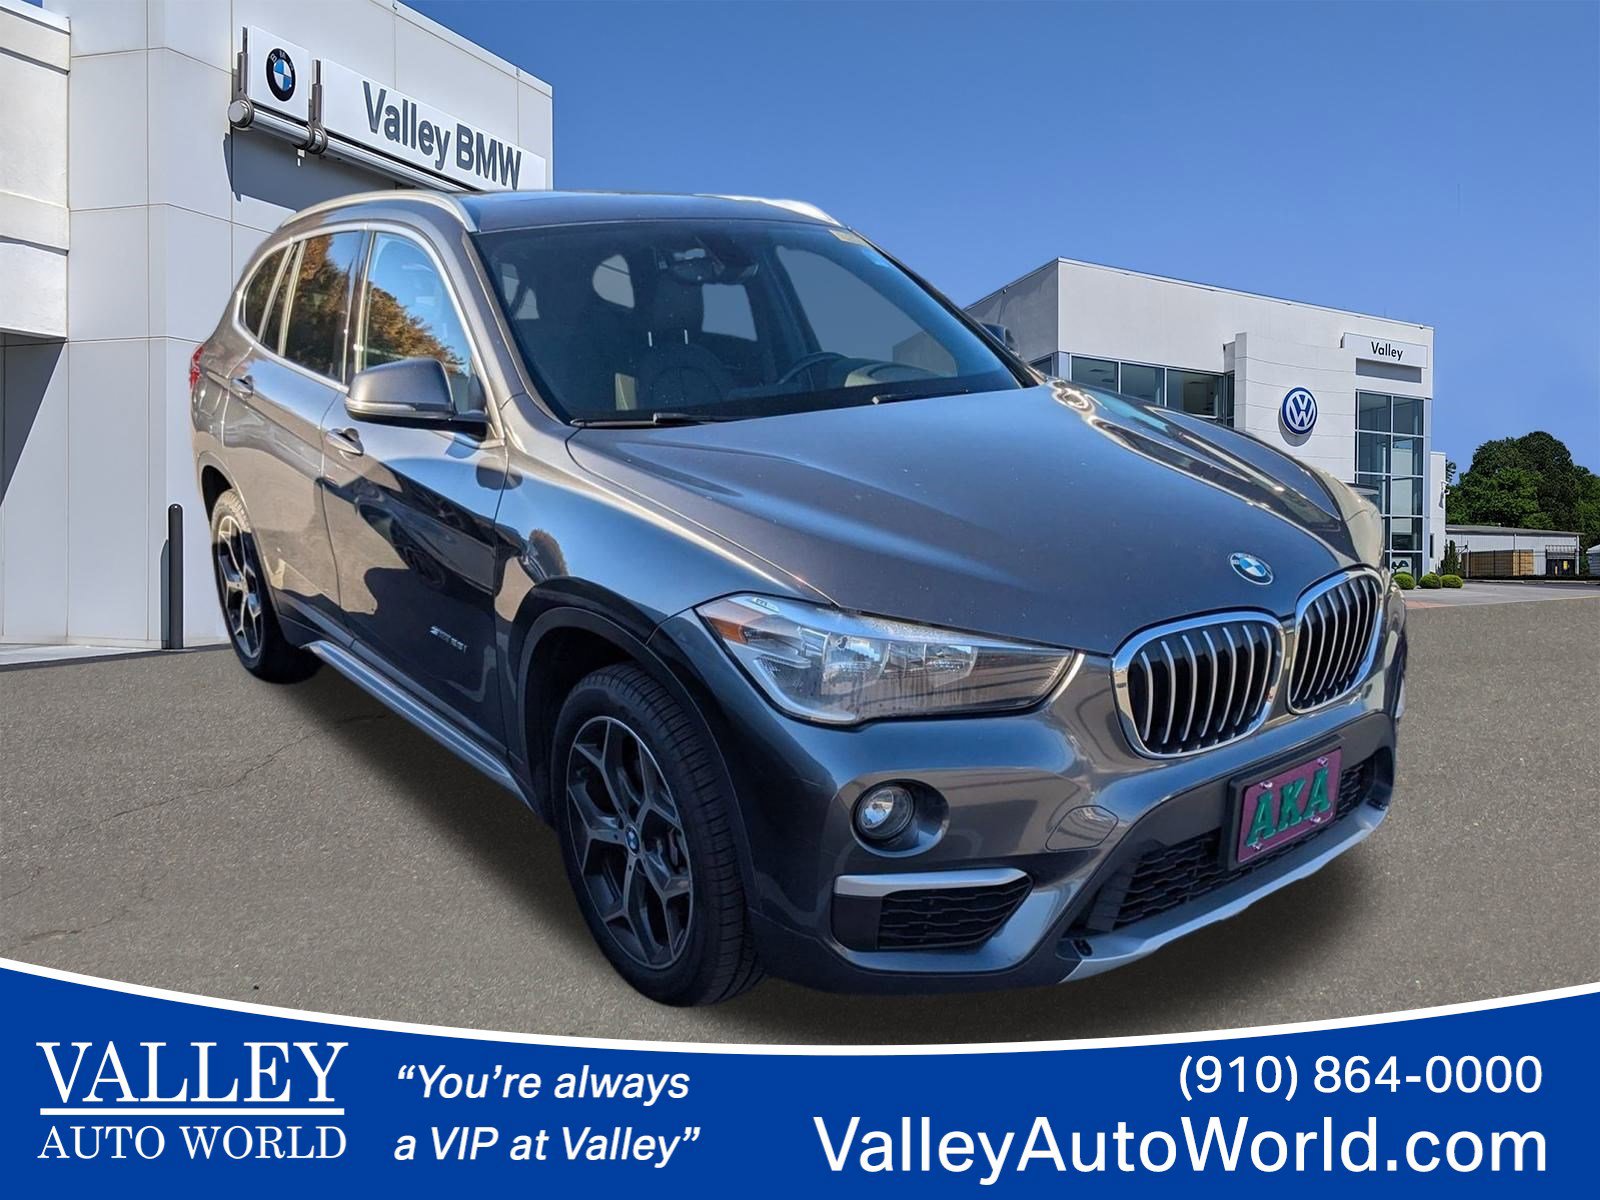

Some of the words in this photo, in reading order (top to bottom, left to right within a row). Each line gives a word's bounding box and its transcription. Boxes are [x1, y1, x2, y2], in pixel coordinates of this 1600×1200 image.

[362, 80, 451, 171] Valley
[456, 122, 522, 191] BMW
[1371, 341, 1403, 360] Valley
[1246, 767, 1332, 848] AKA
